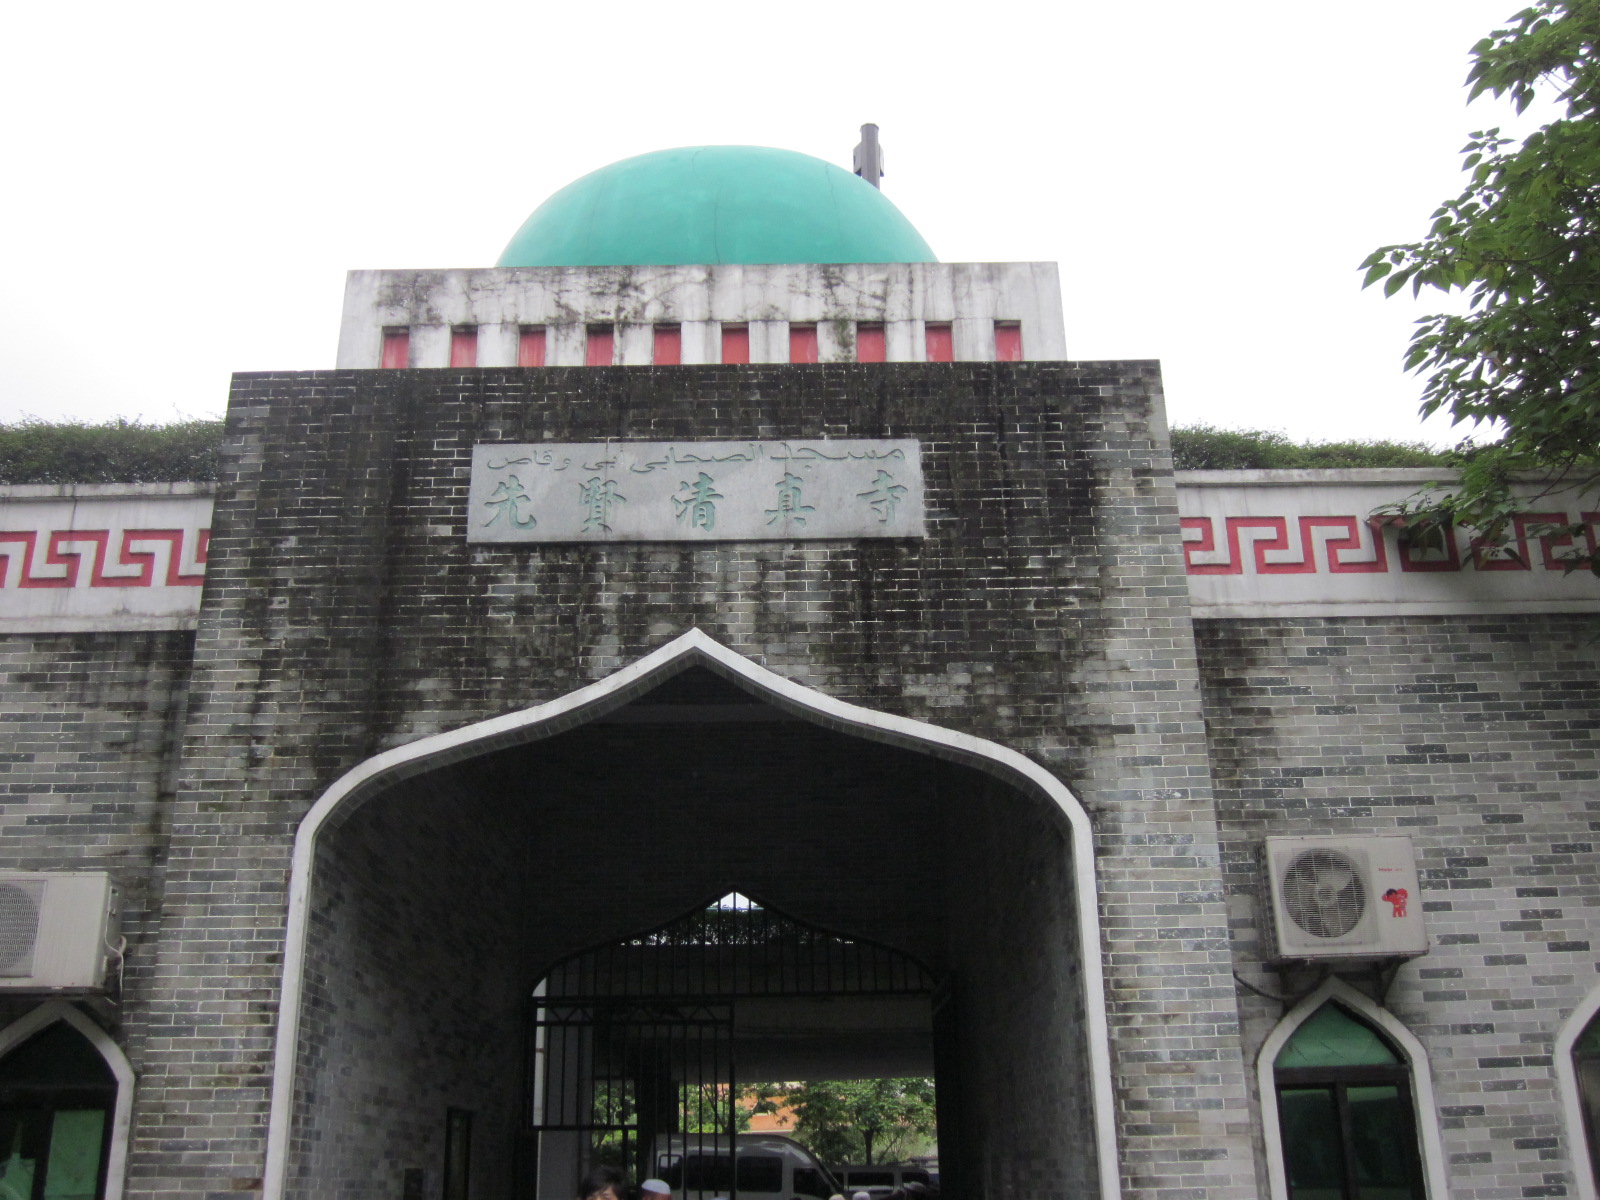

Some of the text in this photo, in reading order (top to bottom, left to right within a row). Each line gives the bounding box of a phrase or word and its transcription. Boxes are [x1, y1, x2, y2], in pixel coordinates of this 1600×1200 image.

[770, 442, 905, 471] مسجد
[483, 469, 908, 533] 先賢清真寺
